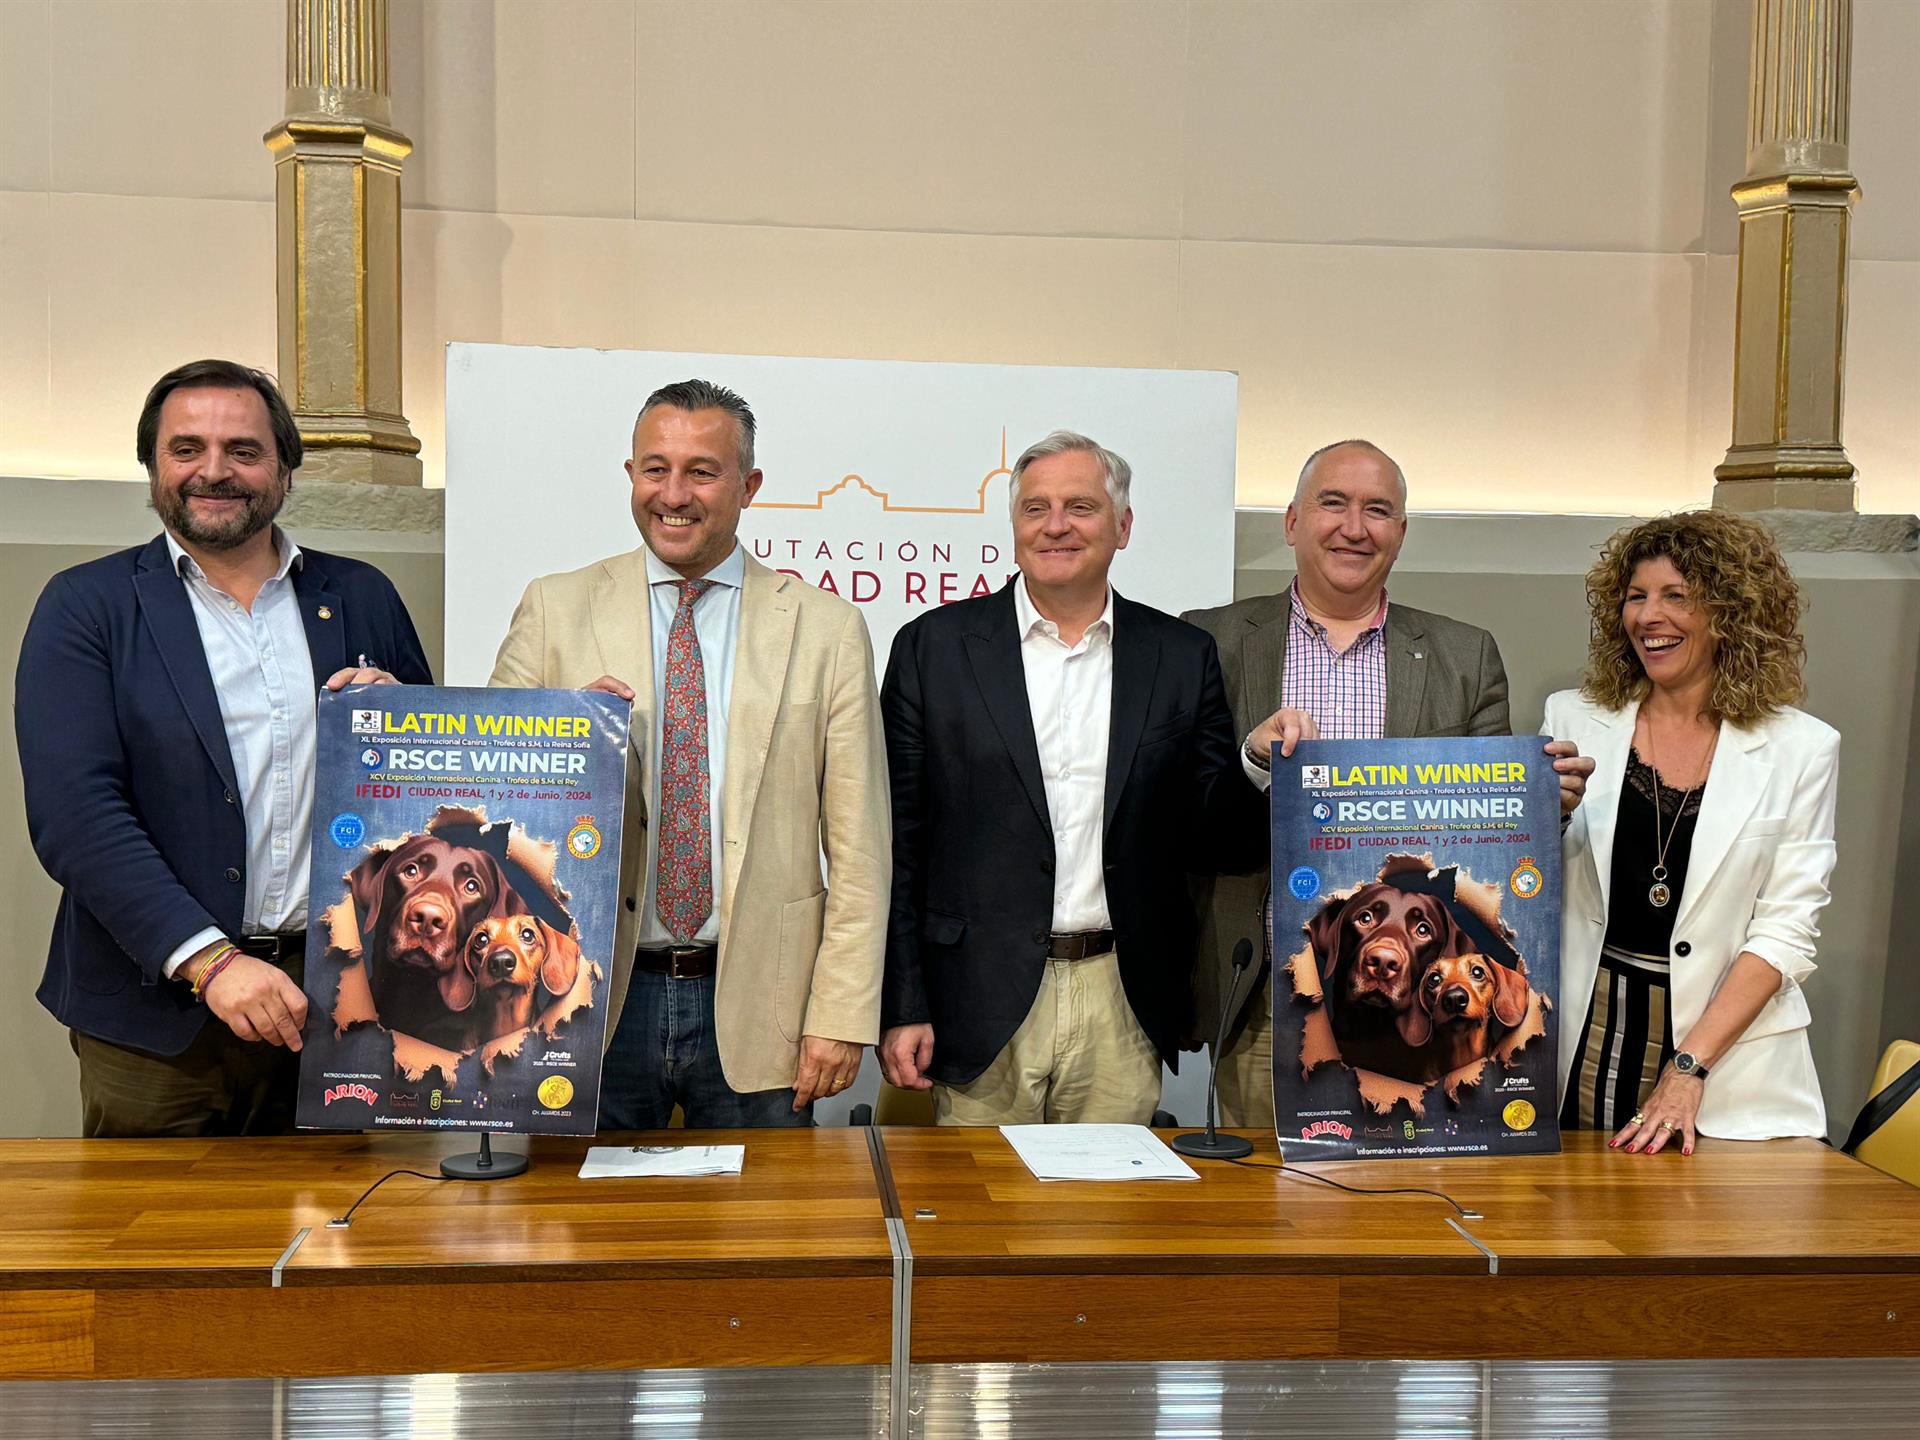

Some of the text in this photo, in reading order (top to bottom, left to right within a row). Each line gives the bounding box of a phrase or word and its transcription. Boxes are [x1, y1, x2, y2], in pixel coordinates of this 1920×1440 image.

[754, 539, 1018, 563] UTACIÓN D
[905, 571, 1011, 604] REA
[384, 712, 466, 734] LATIN
[474, 715, 591, 738] WINNER
[372, 736, 411, 745] Exposición
[412, 738, 461, 746] Internacional
[543, 741, 551, 749] la
[389, 749, 586, 774] RSCE WINNER
[387, 773, 426, 782] Exposición
[427, 775, 475, 783] Internacional
[530, 777, 540, 785] de
[564, 778, 579, 787] Rey
[1332, 765, 1407, 786] LATIN
[1414, 762, 1526, 784] WINNER
[355, 783, 592, 800] IFEDI CIUDAD REAL, 1 y 2 de Junio, 2024
[1321, 789, 1358, 798] Exposición
[1359, 788, 1404, 796] Internacional
[1338, 797, 1524, 822] RSCE WINNER
[1337, 825, 1374, 833] Exposición
[1374, 824, 1419, 832] Internacional
[1420, 823, 1444, 831] Canina
[1472, 822, 1481, 830] de
[1504, 821, 1518, 830] Rey
[1309, 836, 1352, 851] IFEDI
[1358, 837, 1400, 847] CIUDAD
[1434, 836, 1440, 844] 1
[1442, 838, 1449, 847] y
[1451, 836, 1458, 845] 2
[1460, 835, 1473, 844] de
[1474, 835, 1504, 844] Junio,
[1506, 833, 1531, 843] 2024
[324, 1083, 378, 1106] ARION
[375, 1115, 416, 1125] Información
[423, 1116, 468, 1127] inscripciones:
[469, 1119, 514, 1128] www.rsce.es
[1301, 1120, 1352, 1141] ARION
[1356, 1147, 1396, 1155] Información
[1402, 1145, 1447, 1155] inscripciones:
[1447, 1144, 1488, 1153] www.rsce.es
